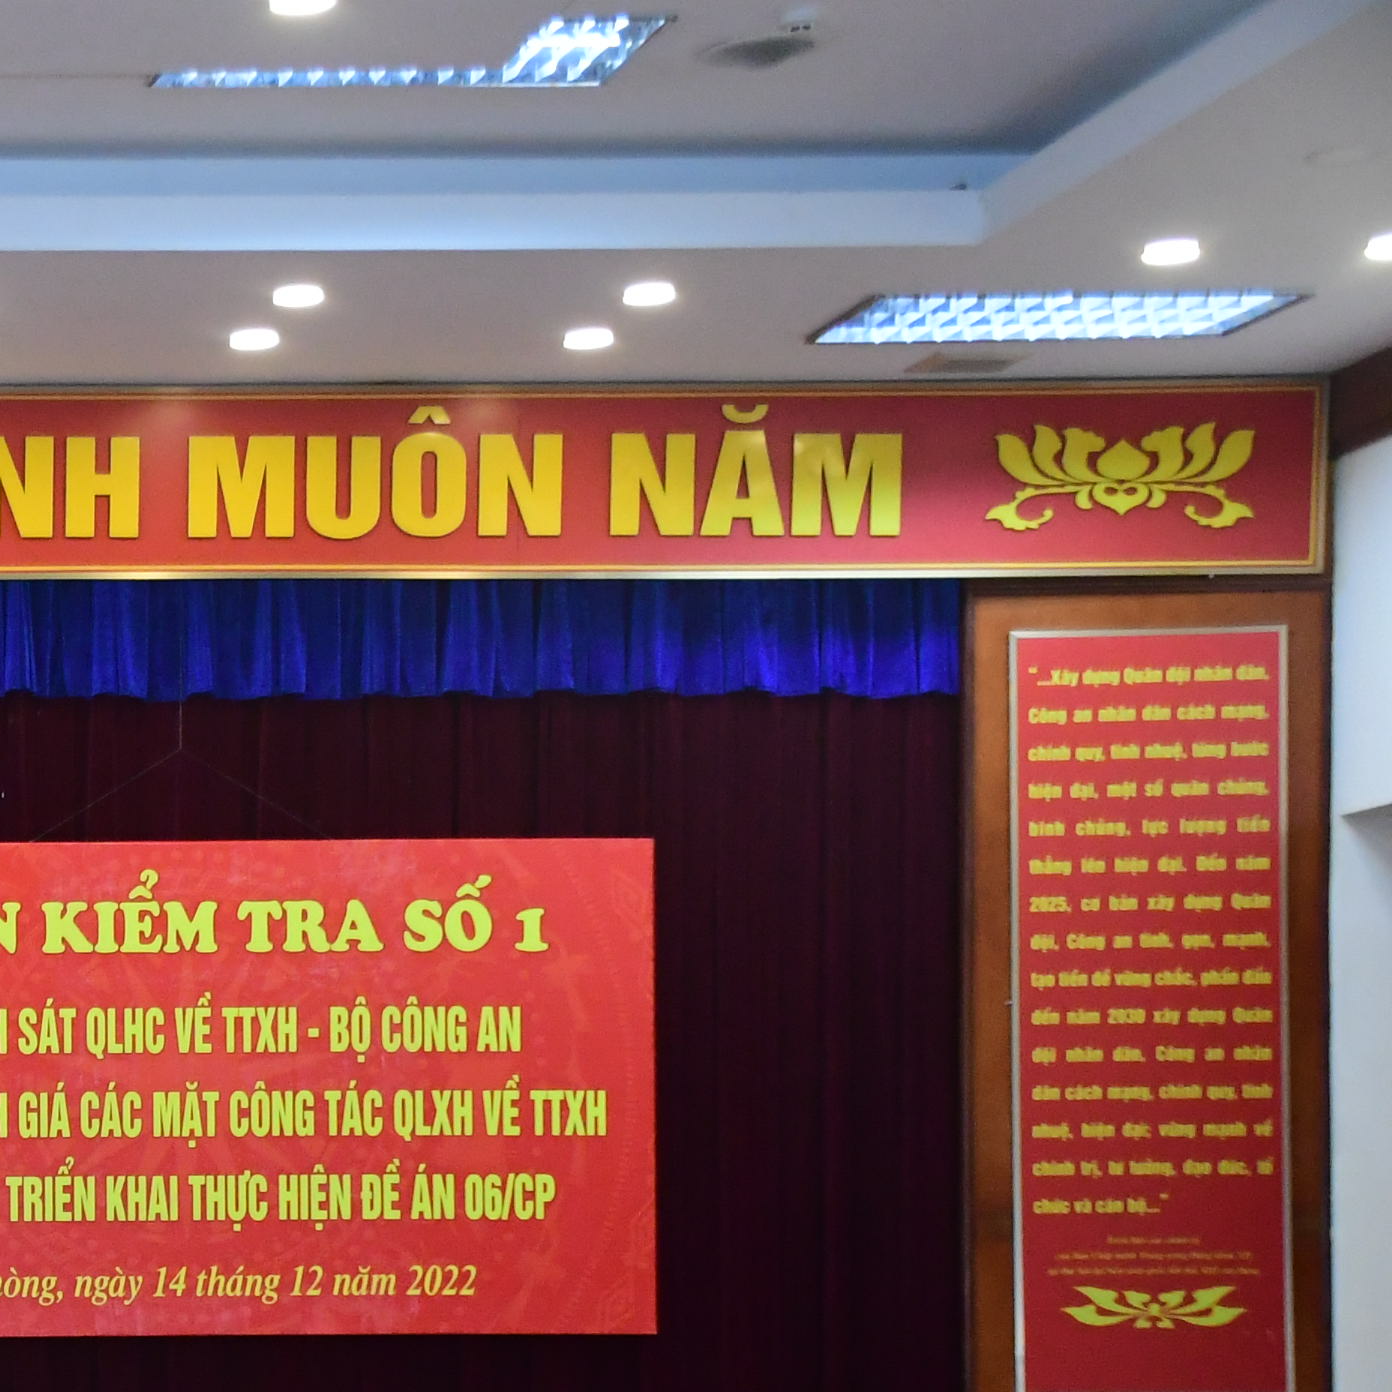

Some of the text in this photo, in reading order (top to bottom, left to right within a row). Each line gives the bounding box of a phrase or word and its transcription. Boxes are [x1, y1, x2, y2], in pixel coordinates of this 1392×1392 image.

[188, 406, 562, 538] MUÔN
[610, 404, 902, 537] NĂM
[42, 869, 217, 953] KIỂM
[237, 899, 384, 952] TRA
[404, 875, 492, 951] SỐ
[515, 908, 548, 952] 1
[18, 998, 76, 1054] SÁT
[87, 1007, 164, 1059] QLHC
[175, 992, 212, 1053] VỀ
[222, 1007, 297, 1053] TTXH
[330, 996, 371, 1062] BỘ
[382, 996, 467, 1052] CÔNG
[477, 1006, 521, 1051] AN
[19, 1082, 70, 1138] GIÁ
[81, 1082, 142, 1138] CÁC
[153, 1082, 219, 1147] MẶT
[230, 1081, 314, 1137] CÔNG
[324, 1080, 383, 1136] TÁC
[394, 1090, 473, 1141] QLXH
[483, 1075, 520, 1135] VỀ
[530, 1090, 606, 1136] TTXH
[6, 1157, 95, 1221] TRIỂN
[106, 1176, 178, 1221] KHAI
[188, 1170, 268, 1231] THỰC
[279, 1164, 351, 1230] HIỆN
[361, 1159, 401, 1219] ĐỀ
[411, 1164, 455, 1219] ÁN
[465, 1173, 555, 1220] 06/CP
[75, 1267, 143, 1305] ngày
[153, 1267, 186, 1297] 14
[196, 1265, 280, 1304] tháng
[290, 1265, 323, 1296] 12
[333, 1266, 396, 1296] năm
[406, 1265, 476, 1296] 2022
